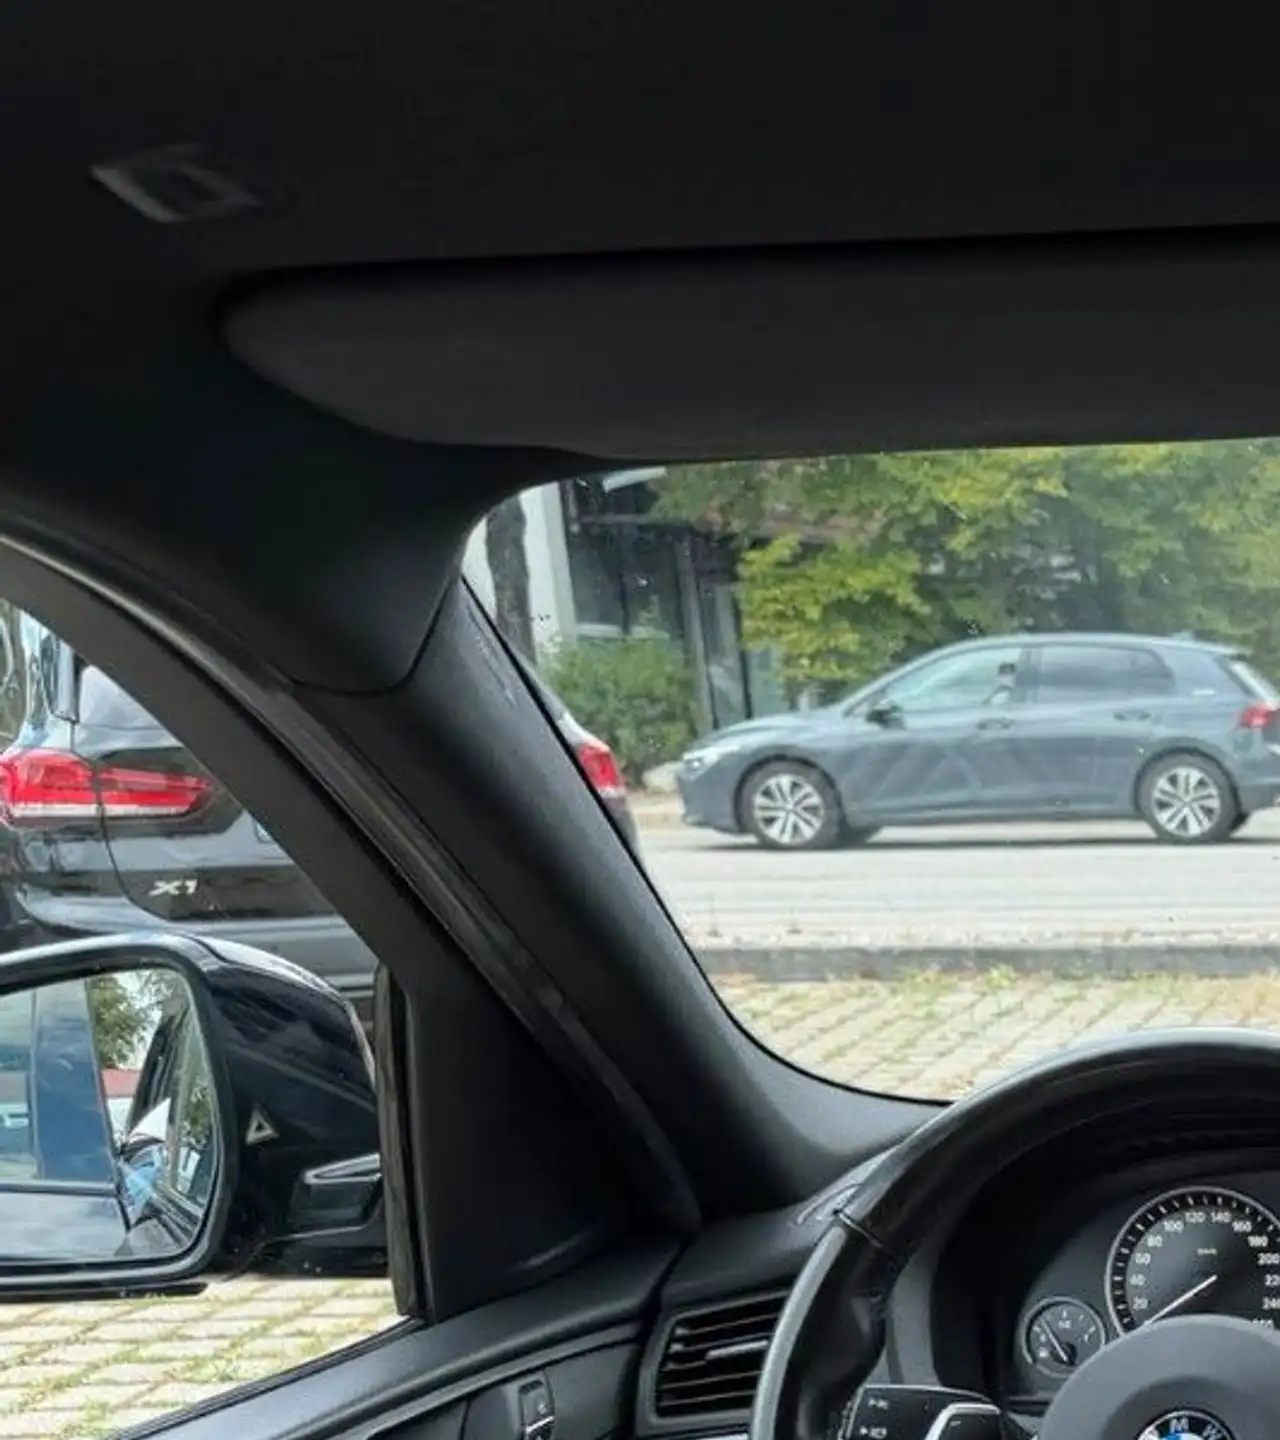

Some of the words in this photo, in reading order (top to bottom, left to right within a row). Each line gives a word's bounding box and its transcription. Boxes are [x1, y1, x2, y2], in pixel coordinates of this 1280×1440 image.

[147, 878, 198, 897] X1
[1184, 1211, 1206, 1223] 120
[1211, 1211, 1232, 1224] 140
[1163, 1220, 1184, 1232] 100
[1231, 1220, 1252, 1232] 160
[1147, 1235, 1164, 1248] 80
[1257, 1252, 1280, 1265] 200
[1132, 1298, 1148, 1310] 20
